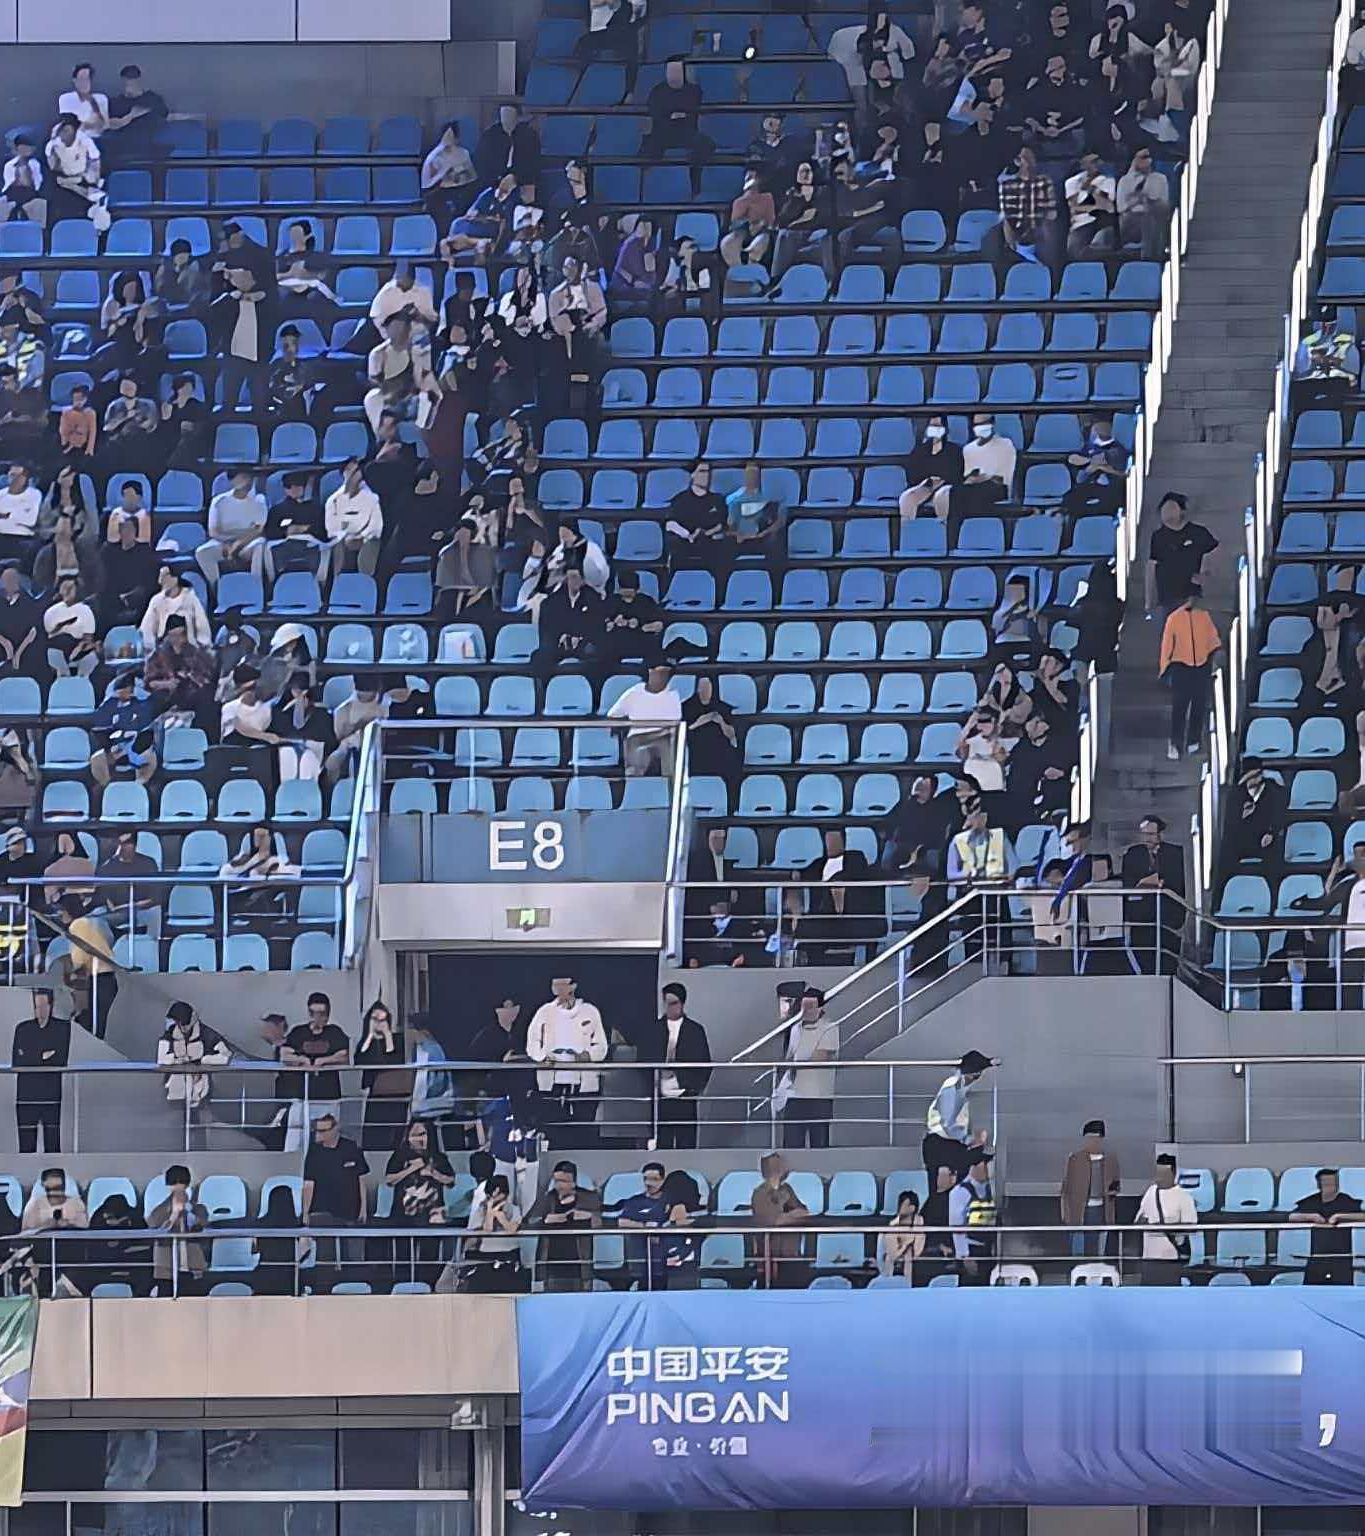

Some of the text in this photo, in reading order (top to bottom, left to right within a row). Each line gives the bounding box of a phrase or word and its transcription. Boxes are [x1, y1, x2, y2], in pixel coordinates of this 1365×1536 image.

[489, 820, 565, 871] E8
[607, 1345, 790, 1386] 中国平安
